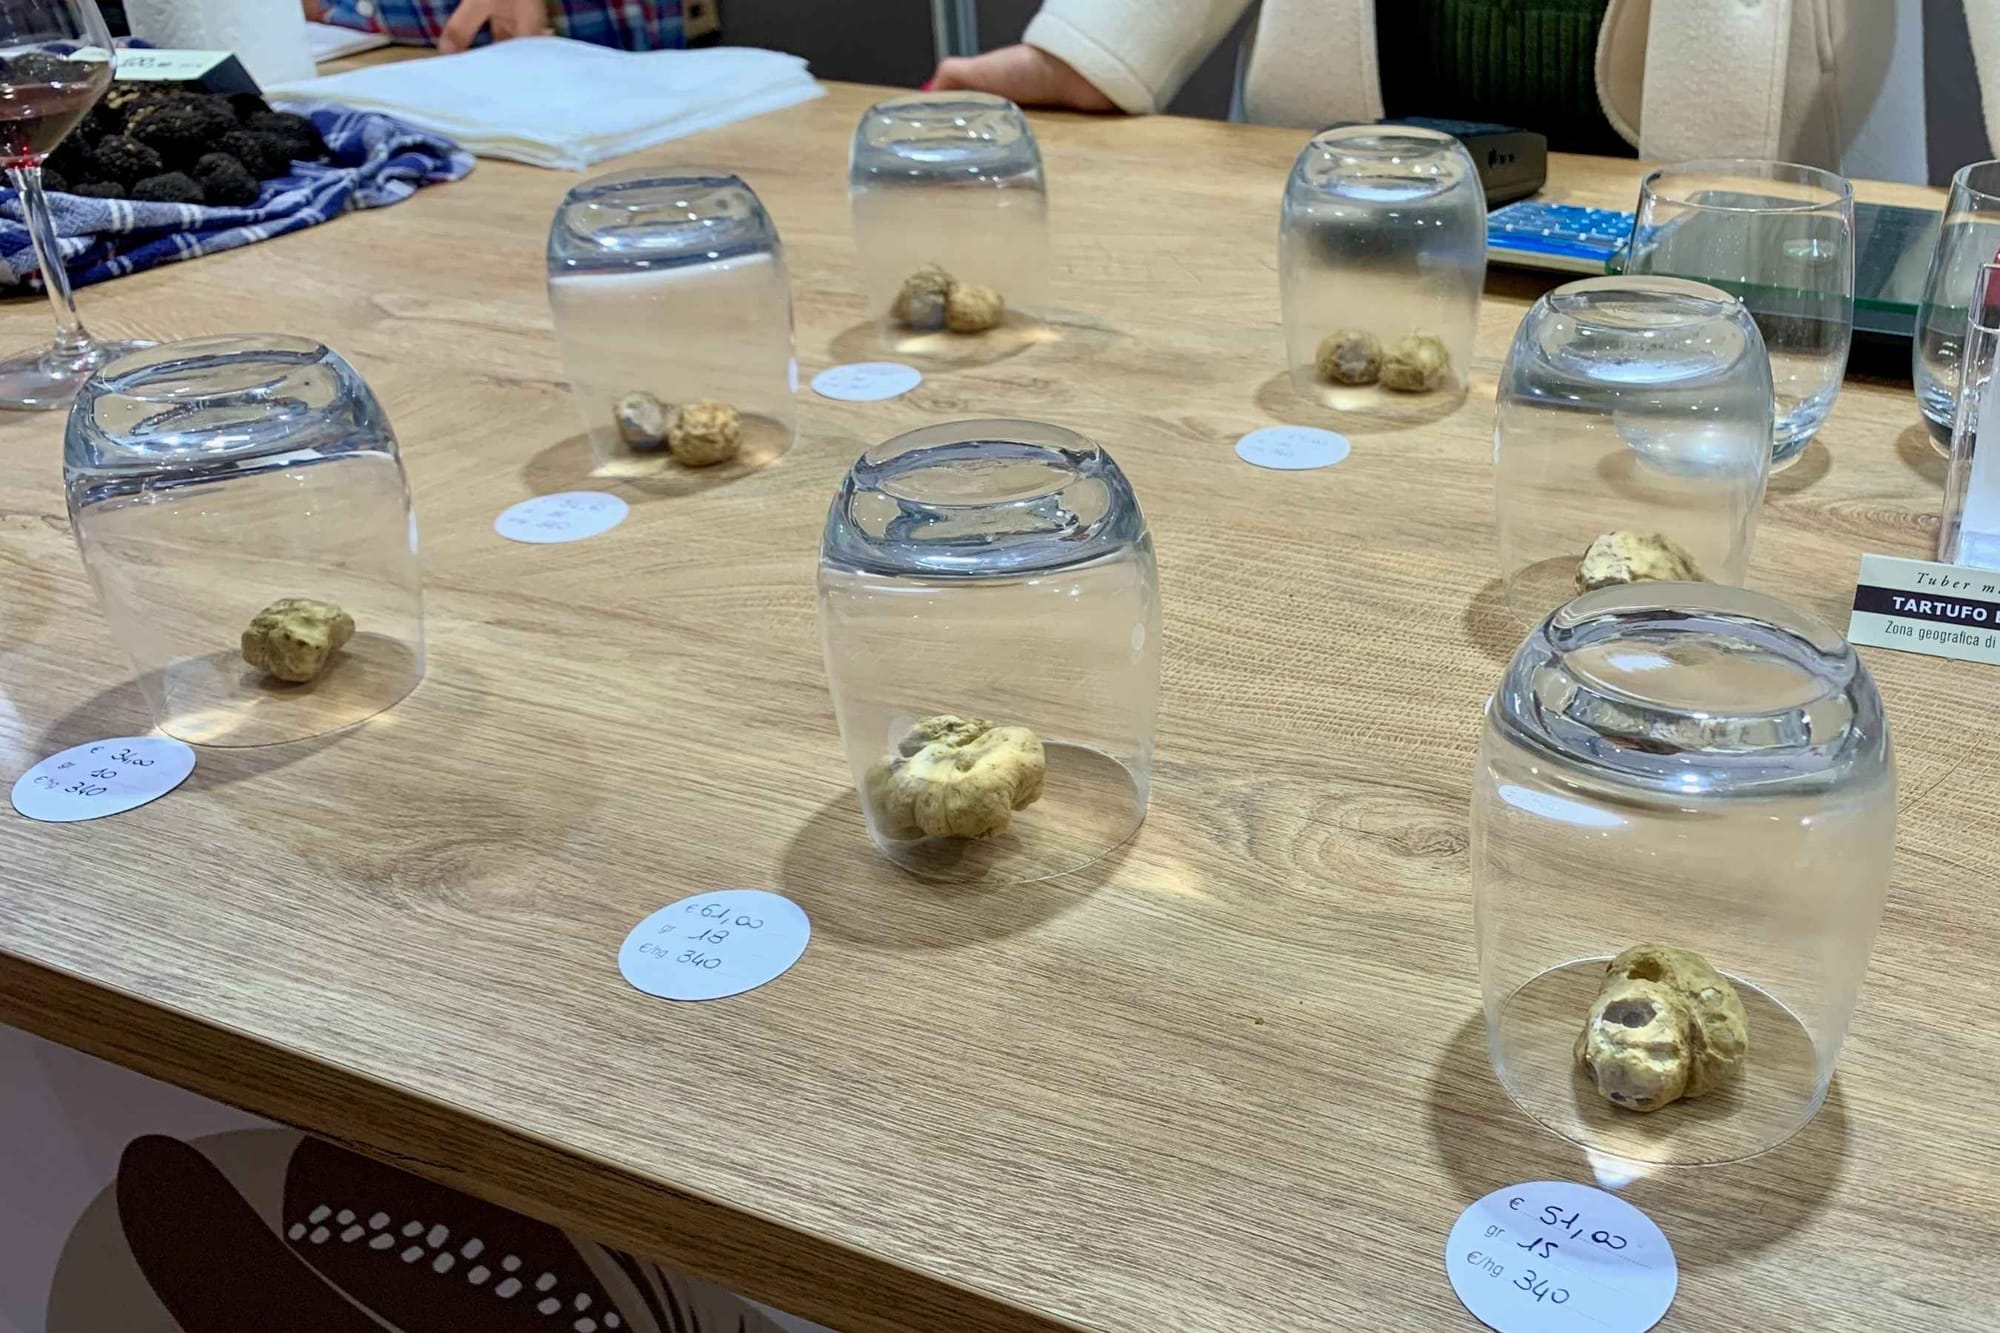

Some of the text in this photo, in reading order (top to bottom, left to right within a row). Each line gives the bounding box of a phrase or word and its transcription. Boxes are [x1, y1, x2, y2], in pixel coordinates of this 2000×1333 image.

[1916, 571, 1971, 591] Tuber
[1892, 596, 1988, 622] TARTUFO
[1885, 620, 1996, 648] Zona geografica di
[90, 767, 118, 779] 10
[658, 923, 730, 944] gr 18
[676, 949, 722, 970] 340
[1509, 1197, 1628, 1250] € 51,00
[1484, 1223, 1559, 1260] gr 15
[1466, 1250, 1570, 1305] €/hg 340
